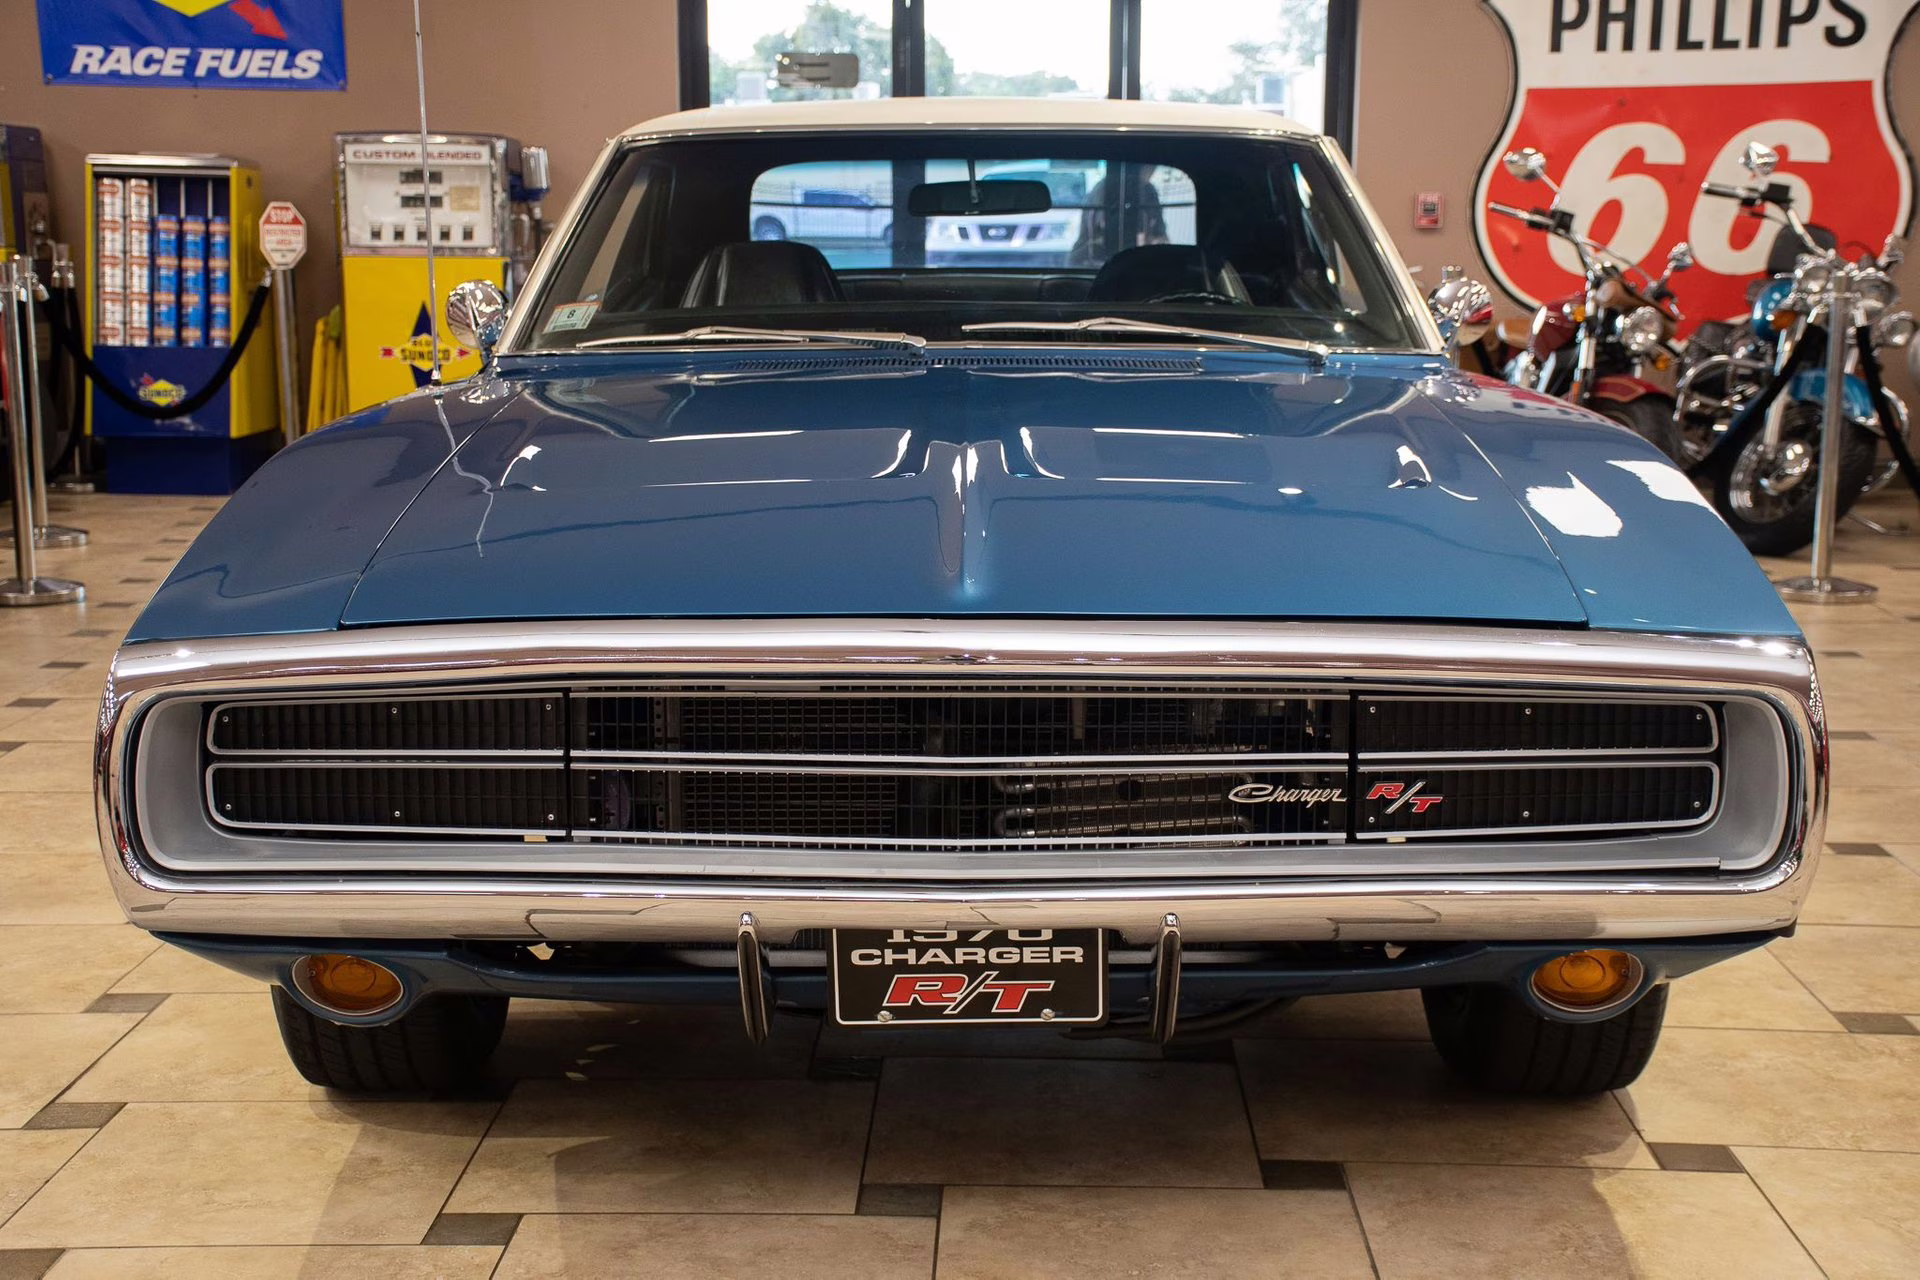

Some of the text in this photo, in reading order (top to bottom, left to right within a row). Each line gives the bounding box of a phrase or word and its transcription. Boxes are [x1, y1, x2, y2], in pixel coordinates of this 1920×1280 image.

[1550, 0, 1867, 53] PHILLIPS
[70, 45, 323, 80] RACE FUELS
[352, 150, 417, 161] CUSTOM
[270, 208, 295, 223] STOP
[1547, 119, 1832, 277] 66
[1228, 783, 1347, 809] Charger
[1366, 779, 1443, 815] R/T
[850, 946, 1084, 965] CHARGER
[882, 971, 1056, 1015] R/T
